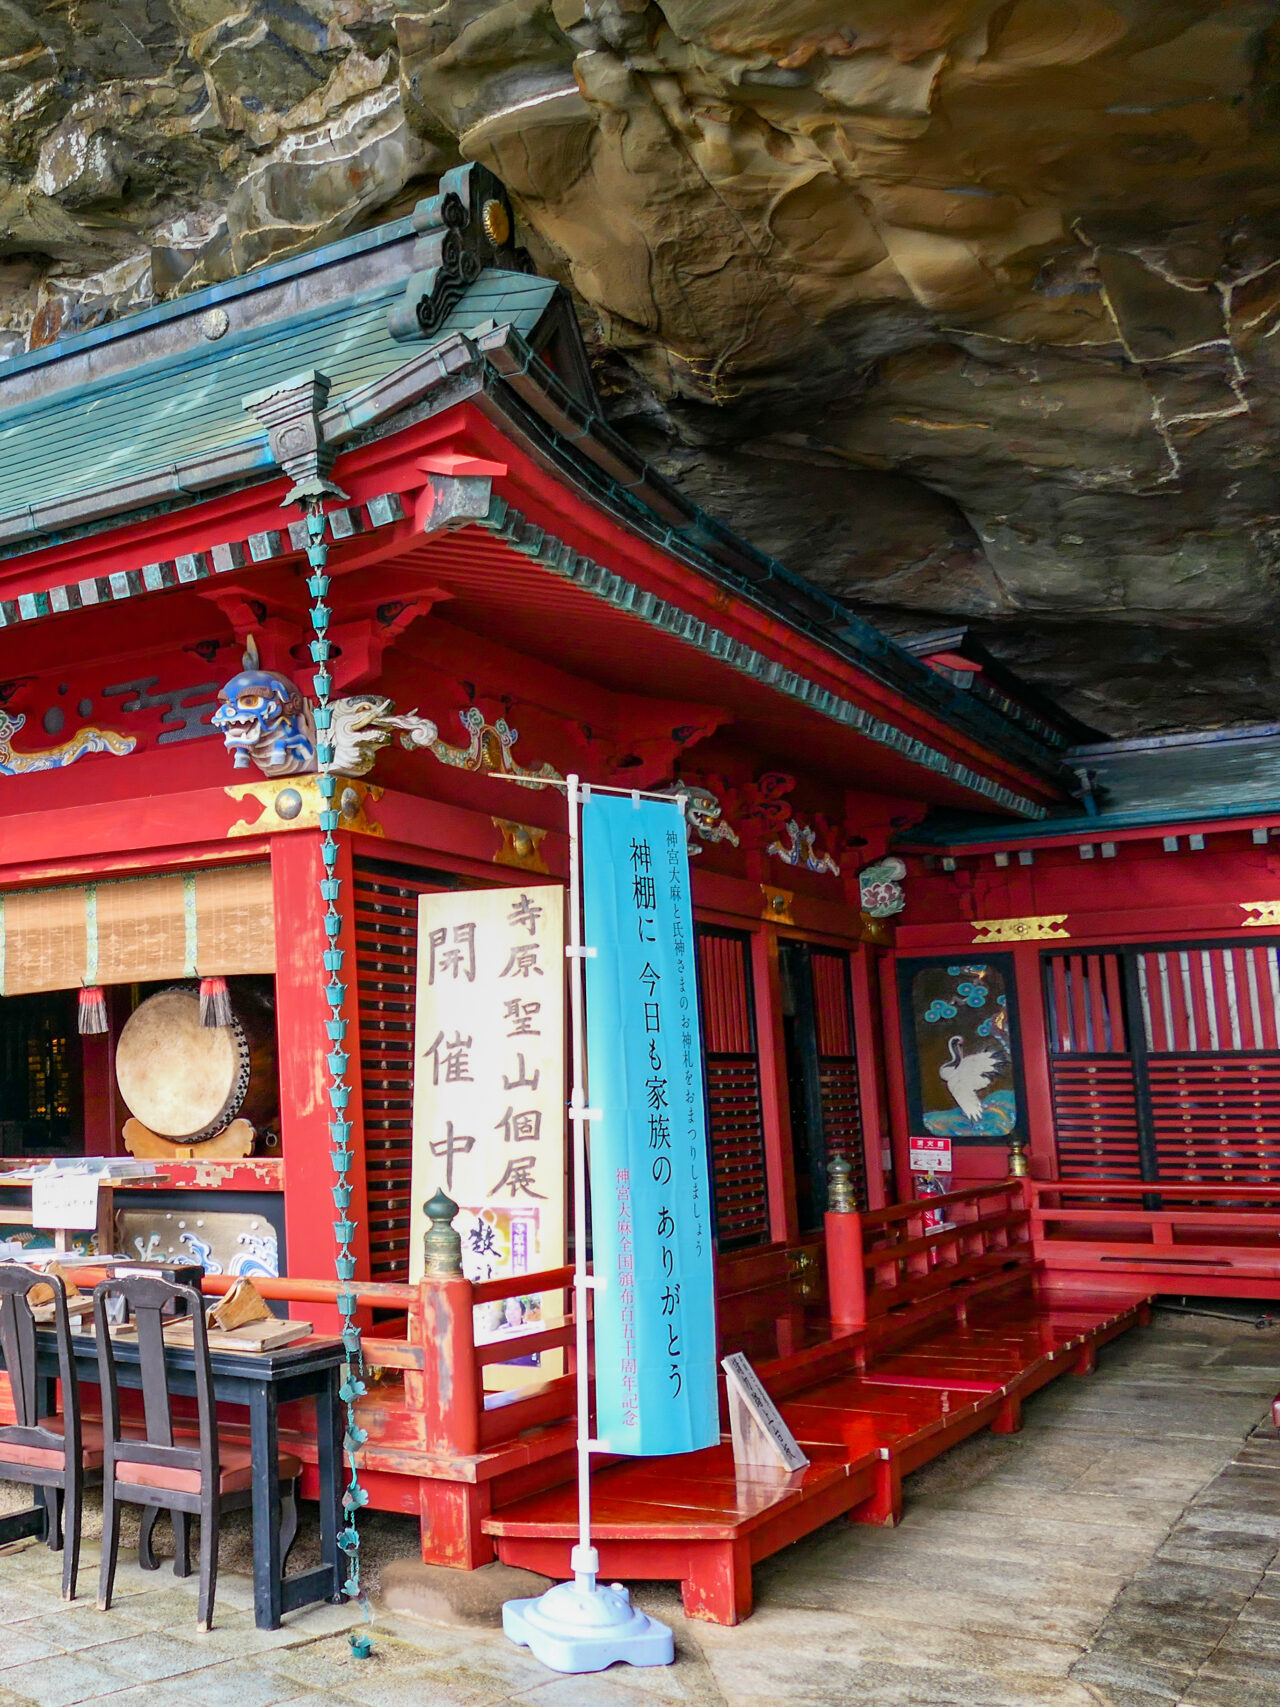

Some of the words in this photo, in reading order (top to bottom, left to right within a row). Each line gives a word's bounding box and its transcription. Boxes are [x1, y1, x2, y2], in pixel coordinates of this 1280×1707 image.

[629, 837, 656, 943] 神棚に
[422, 922, 477, 1193] 開催中
[487, 893, 549, 1200] 寺原聖山個展
[638, 961, 672, 1186] 今日も家族の
[665, 829, 702, 1257] 神宮大麻と氏神さまのお神札をおまつりしましょう
[616, 1167, 639, 1427] 神宮大麻全国頒布百五十周年記念
[657, 1205, 682, 1399] ありがとう
